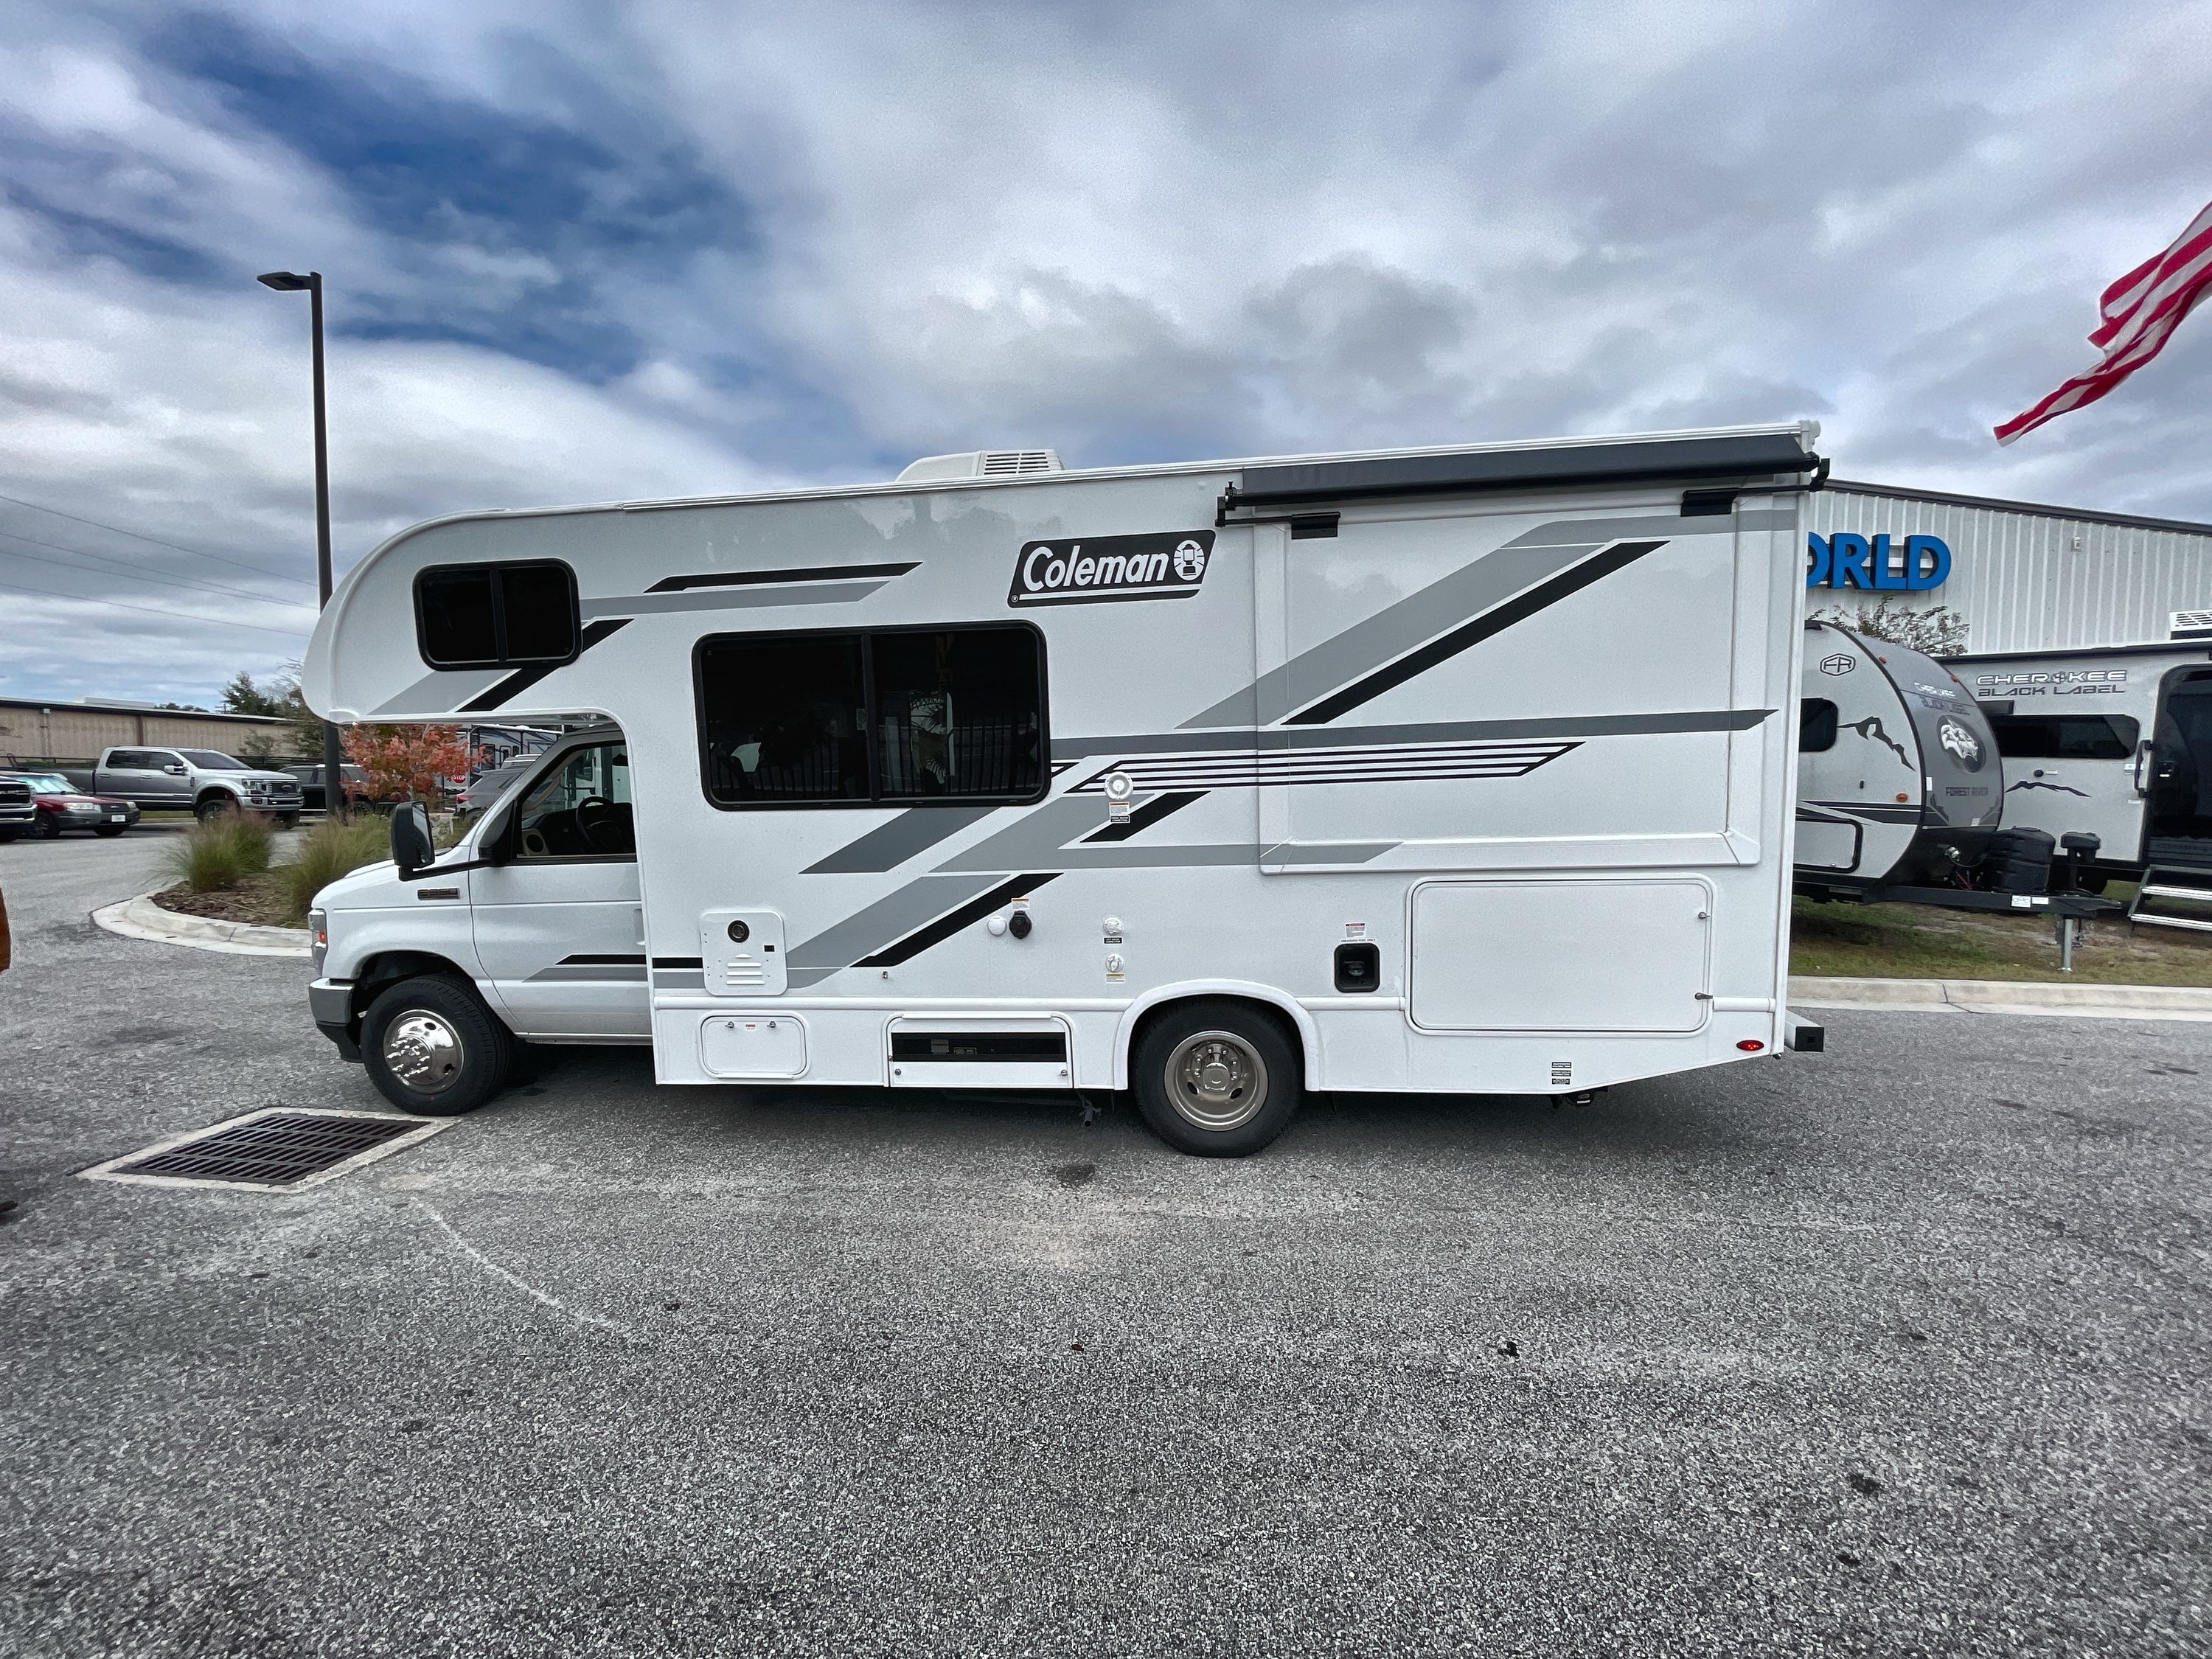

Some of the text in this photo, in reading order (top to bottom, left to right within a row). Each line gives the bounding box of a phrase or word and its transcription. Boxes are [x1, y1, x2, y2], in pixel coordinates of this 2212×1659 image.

[1023, 545, 1169, 591] Coleman
[1978, 684, 2125, 697] BLACK LABEL
